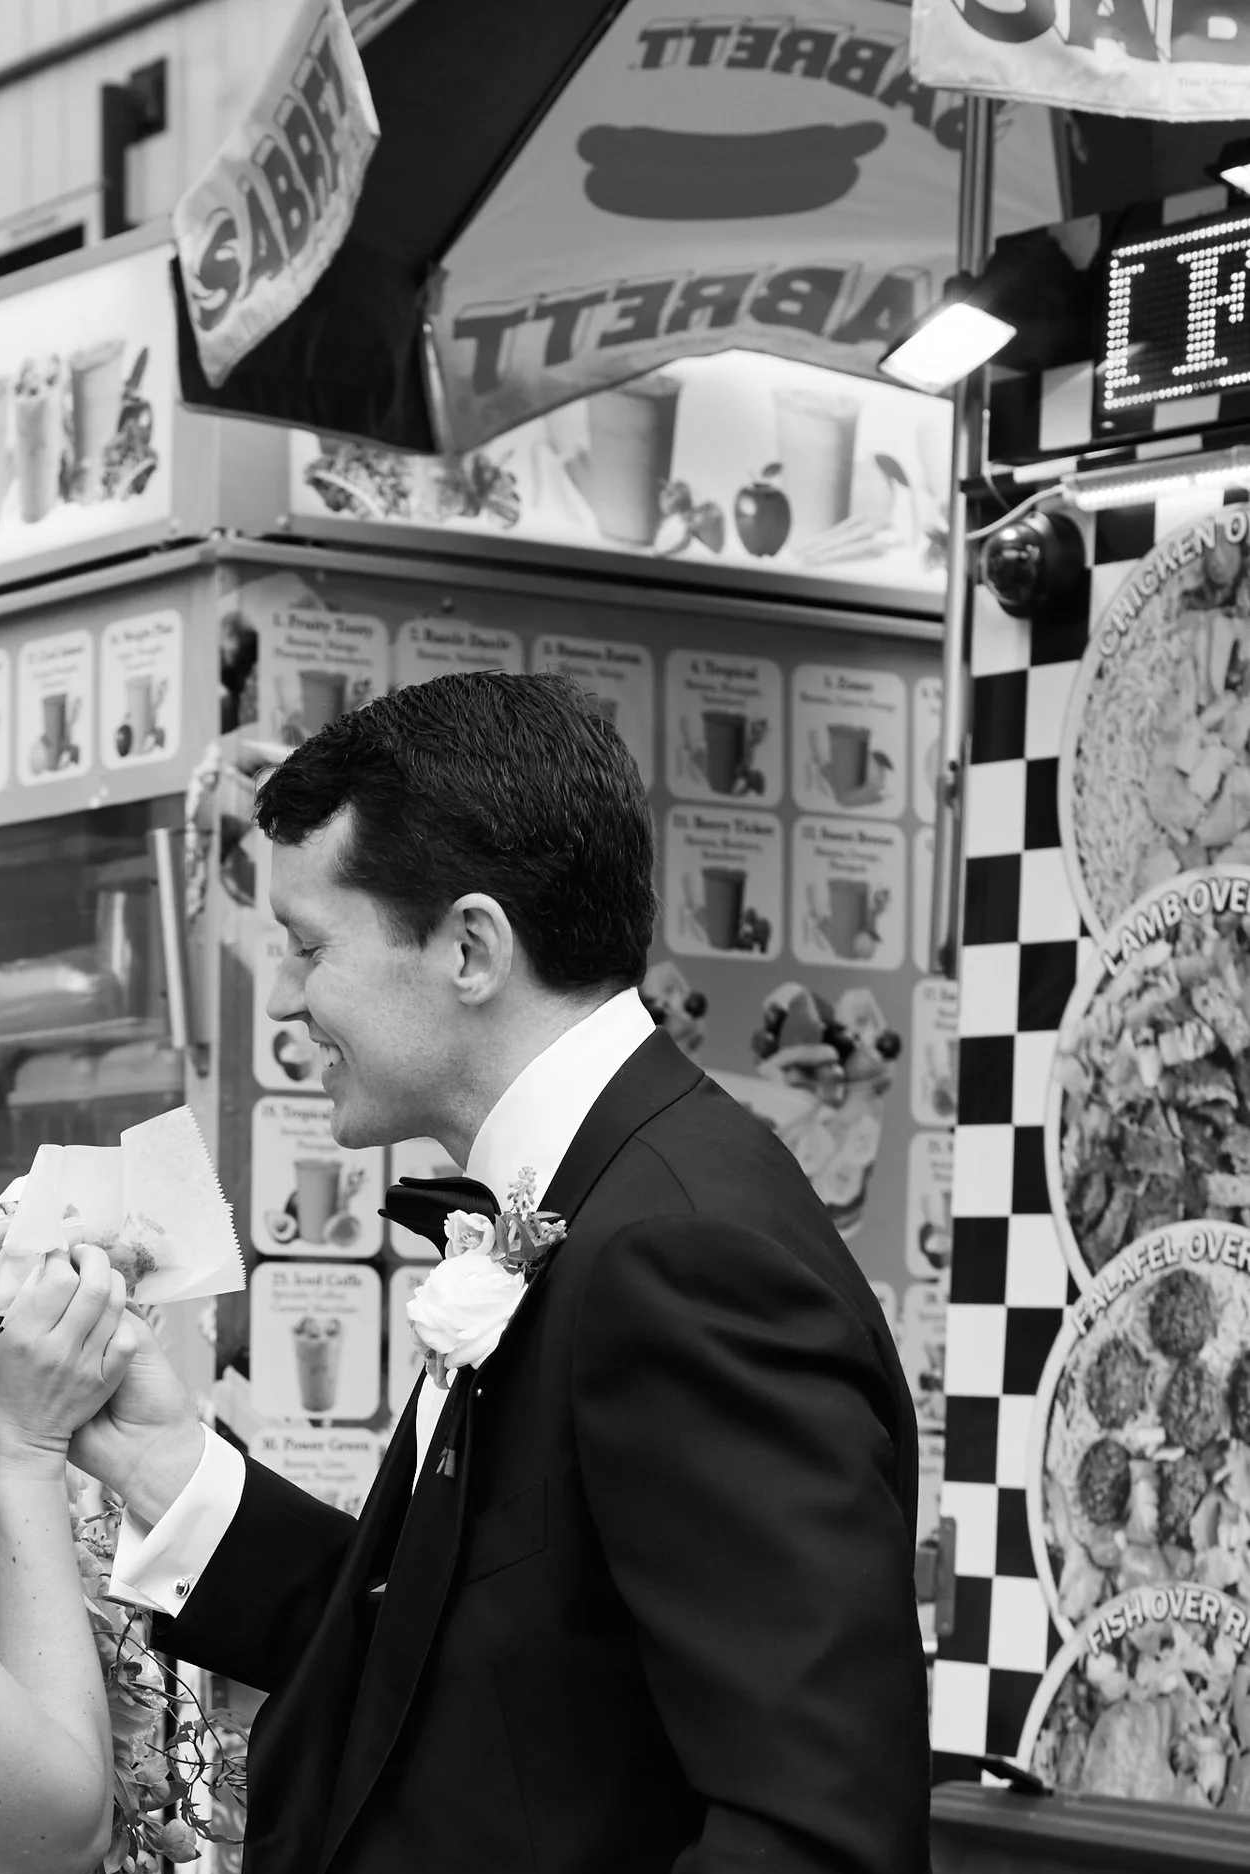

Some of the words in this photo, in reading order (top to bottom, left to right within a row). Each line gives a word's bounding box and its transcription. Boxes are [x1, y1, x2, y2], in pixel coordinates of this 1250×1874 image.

[1099, 513, 1218, 658] CHICKEN
[1100, 888, 1183, 977] LAMB
[1187, 876, 1250, 917] OVE
[1071, 1231, 1180, 1336] FALAFEL
[1087, 1589, 1150, 1655] FISH
[1152, 1586, 1222, 1628] OVER
